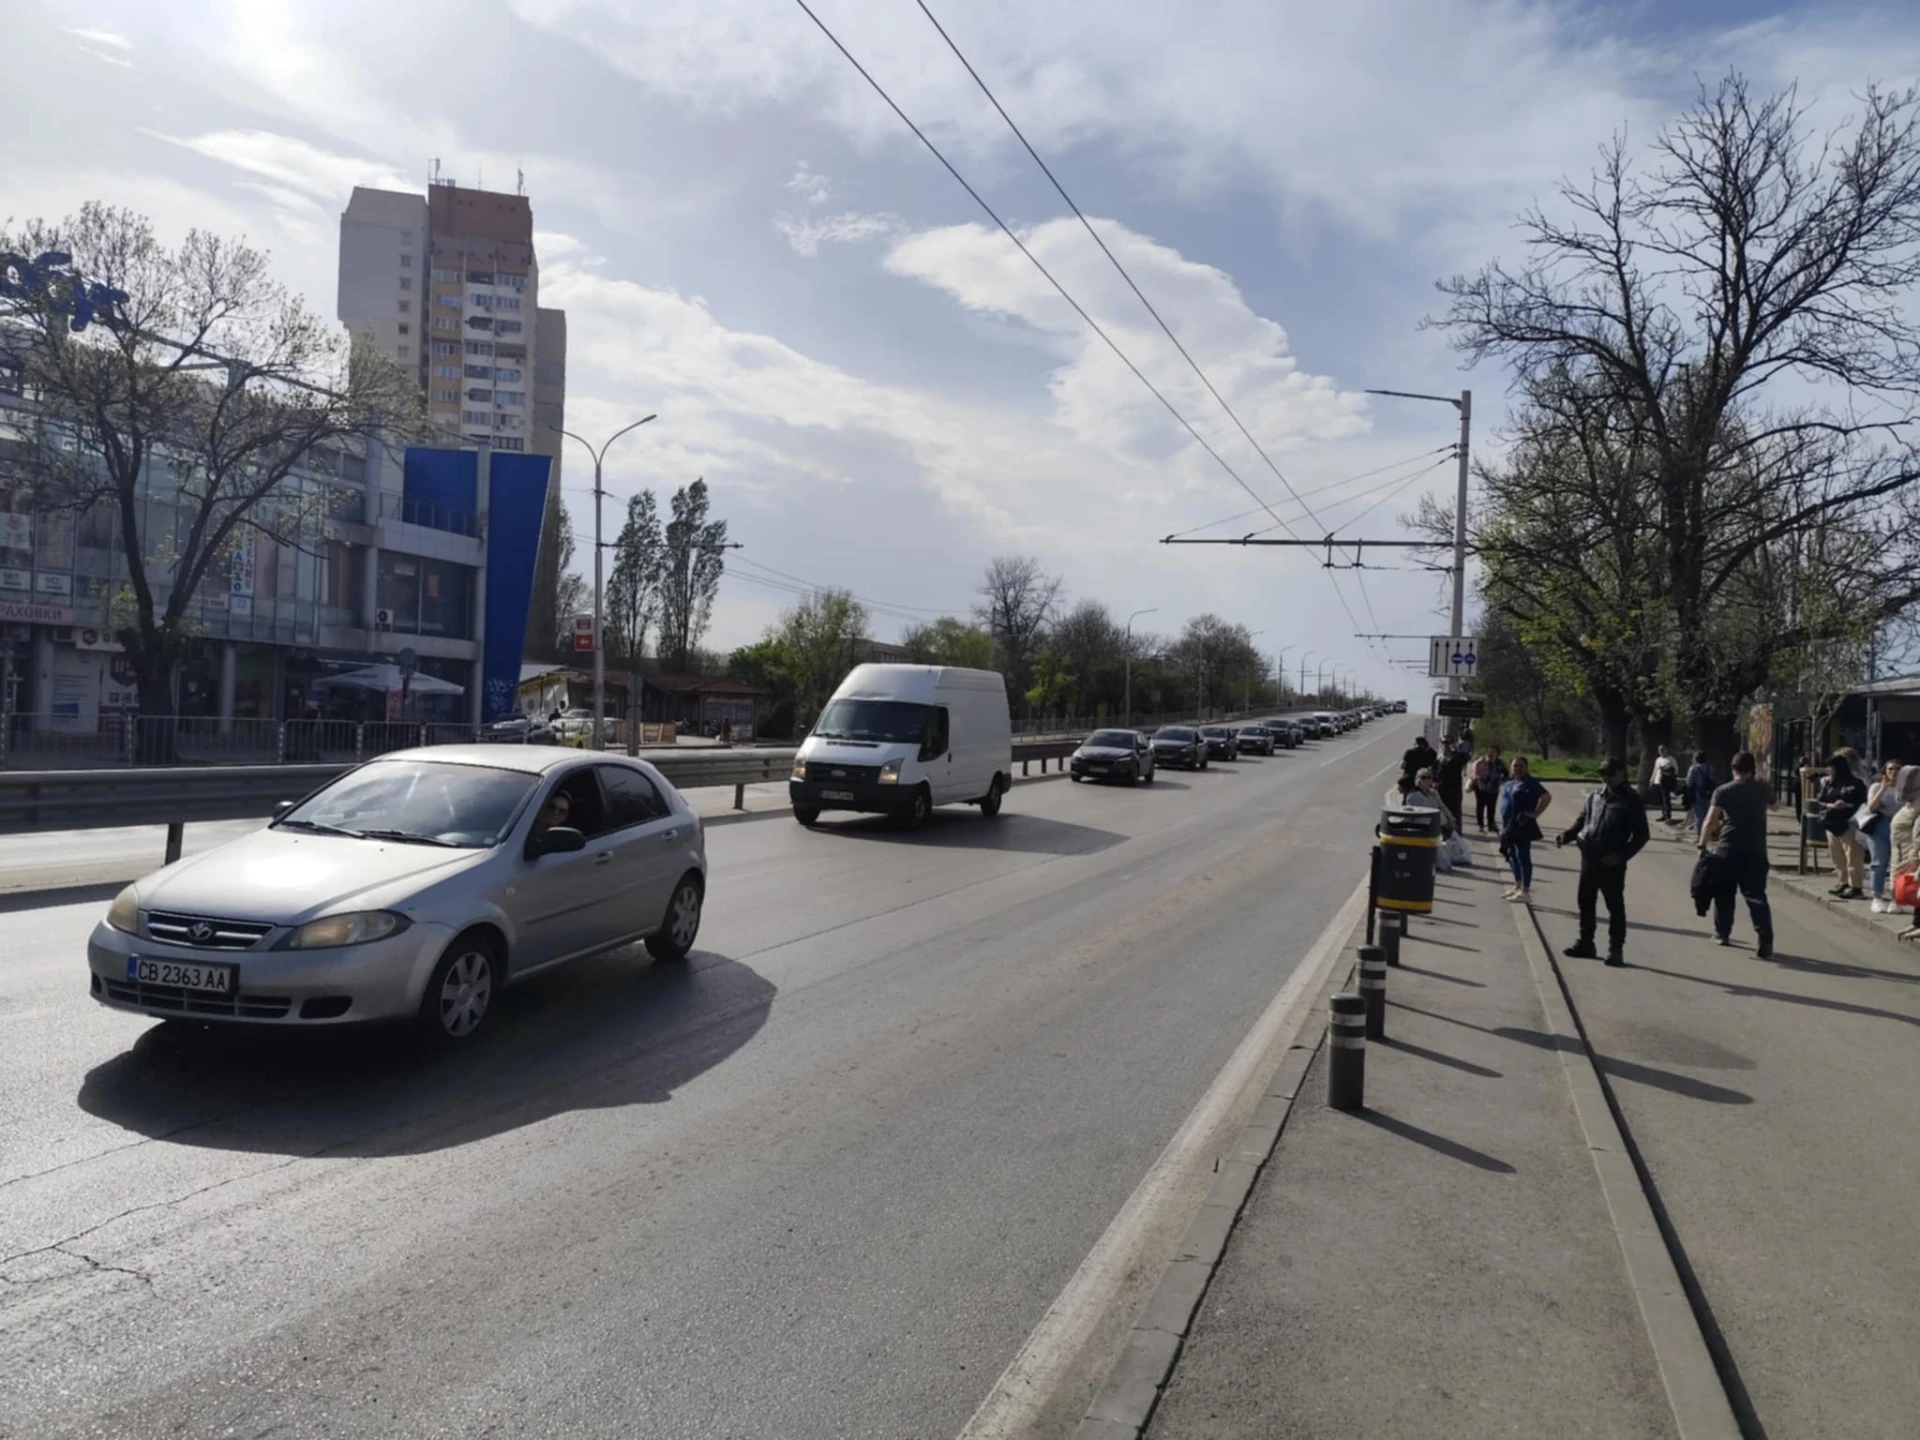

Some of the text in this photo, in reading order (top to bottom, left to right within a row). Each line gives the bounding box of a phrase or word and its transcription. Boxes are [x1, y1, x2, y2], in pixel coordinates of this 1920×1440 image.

[138, 961, 226, 990] CB 2363 AA
